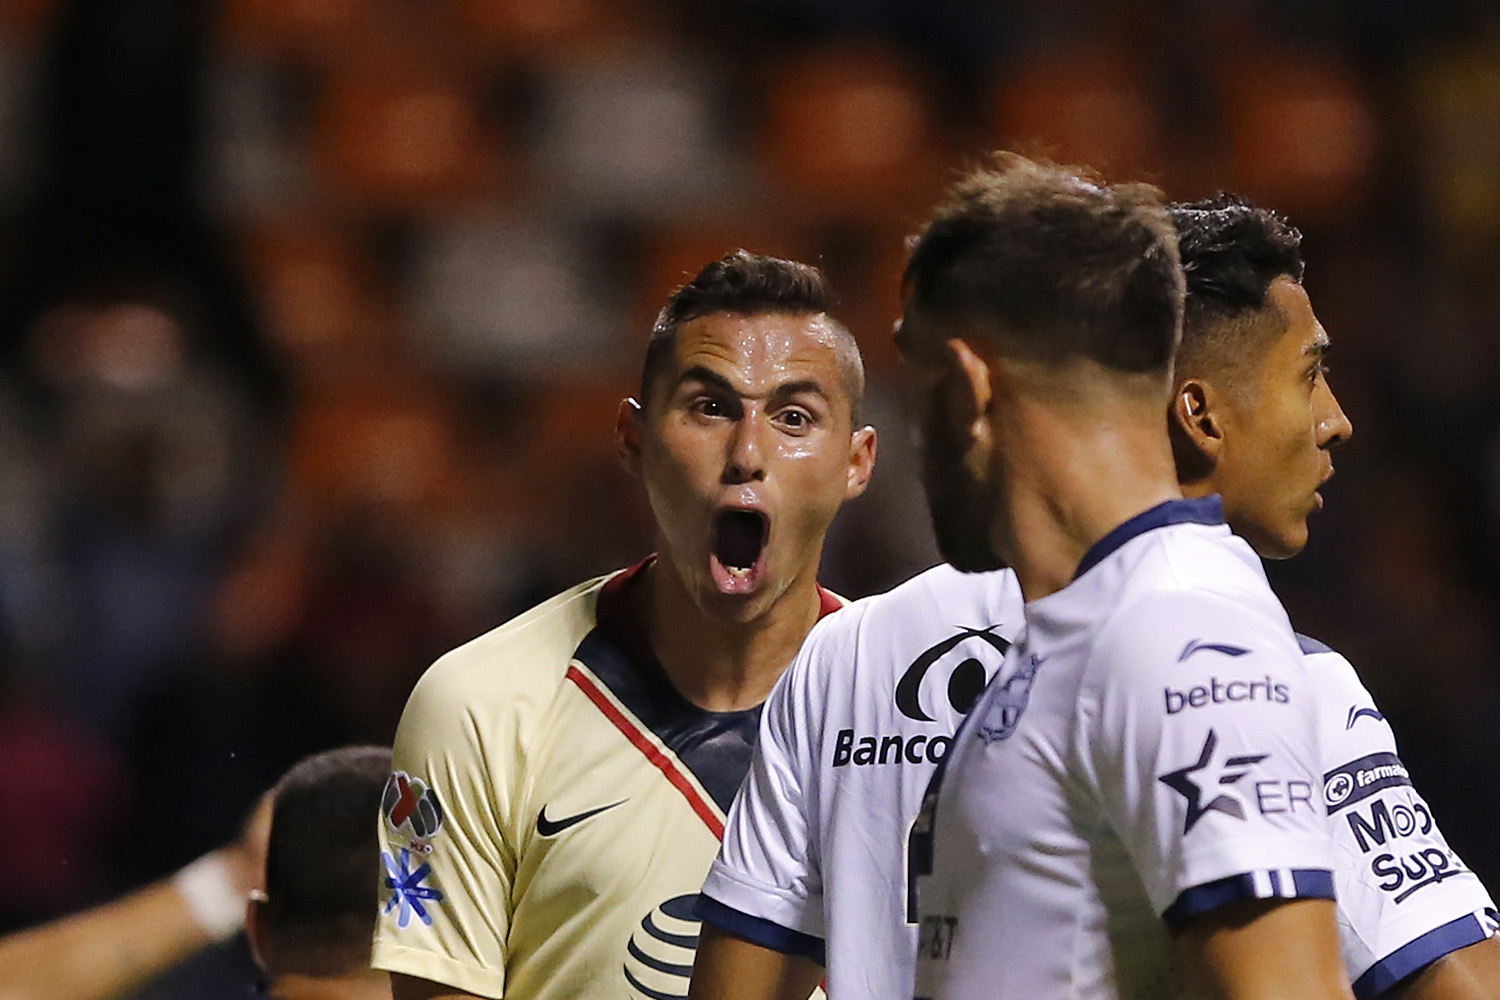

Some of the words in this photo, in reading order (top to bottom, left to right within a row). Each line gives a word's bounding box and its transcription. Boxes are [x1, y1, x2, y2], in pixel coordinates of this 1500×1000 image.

[1164, 675, 1290, 715] betcris
[832, 729, 954, 767] Banco
[1256, 780, 1317, 815] ER
[1371, 848, 1461, 892] Sup
